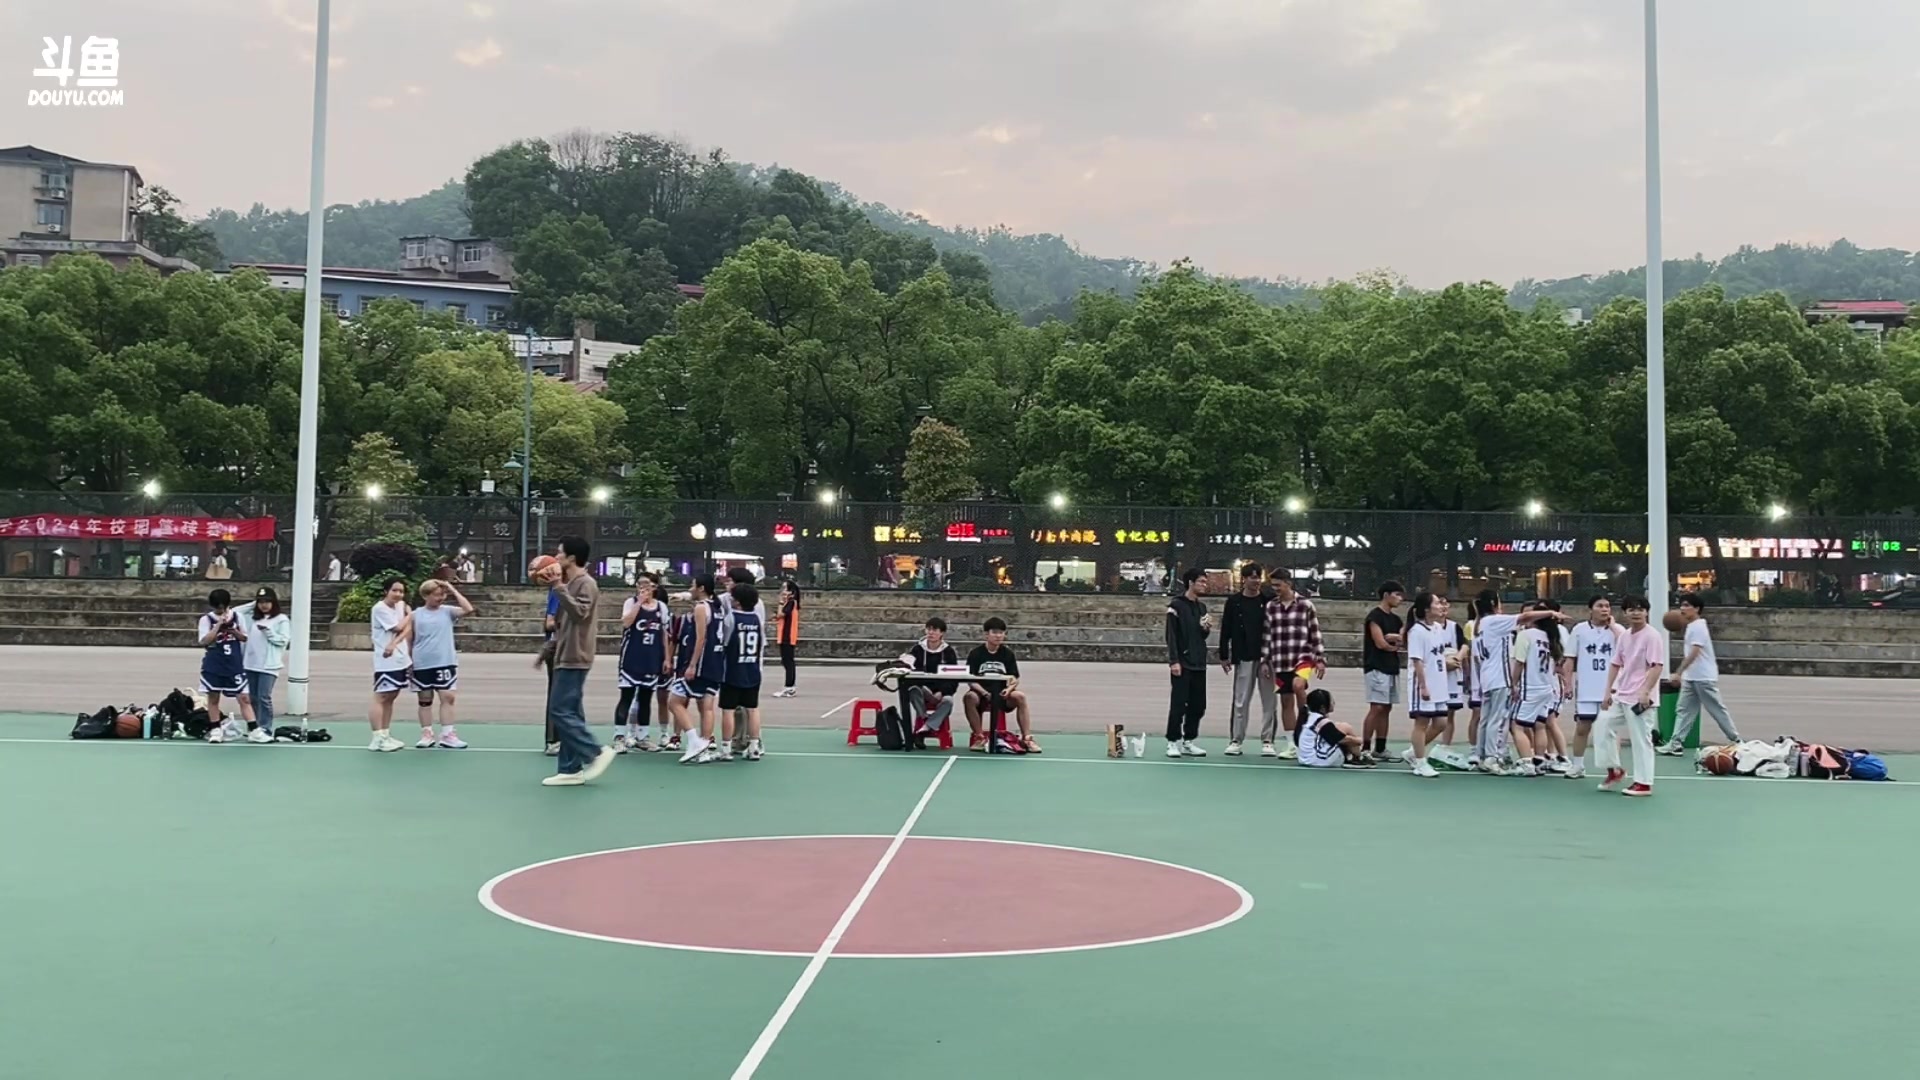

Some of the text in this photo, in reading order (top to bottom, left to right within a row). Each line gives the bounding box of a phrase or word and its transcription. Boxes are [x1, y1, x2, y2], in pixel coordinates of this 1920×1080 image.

[1535, 538, 1576, 553] MARIO
[643, 633, 655, 645] 21
[738, 631, 758, 655] 19
[222, 644, 232, 655] 5
[1592, 658, 1606, 671] 03
[436, 669, 452, 681] 30
